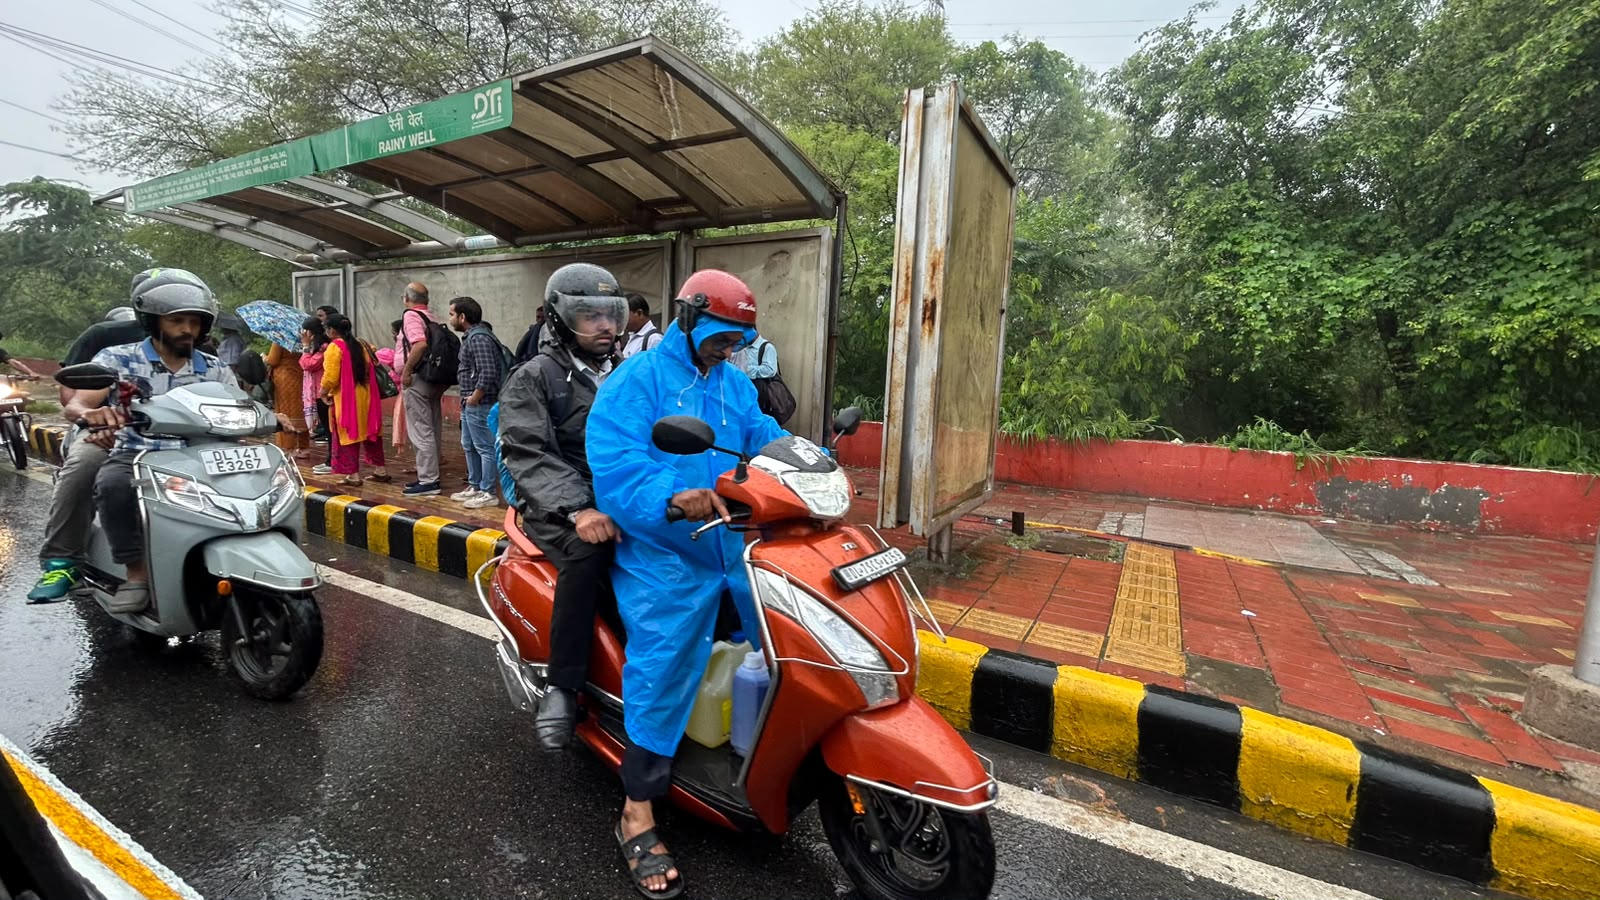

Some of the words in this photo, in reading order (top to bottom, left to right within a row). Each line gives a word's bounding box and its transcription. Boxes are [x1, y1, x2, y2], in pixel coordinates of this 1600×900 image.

[407, 110, 424, 128] वेल
[378, 135, 407, 154] RAINY
[408, 129, 436, 147] WELL
[213, 448, 258, 462] DL14T
[216, 459, 262, 473] E3267
